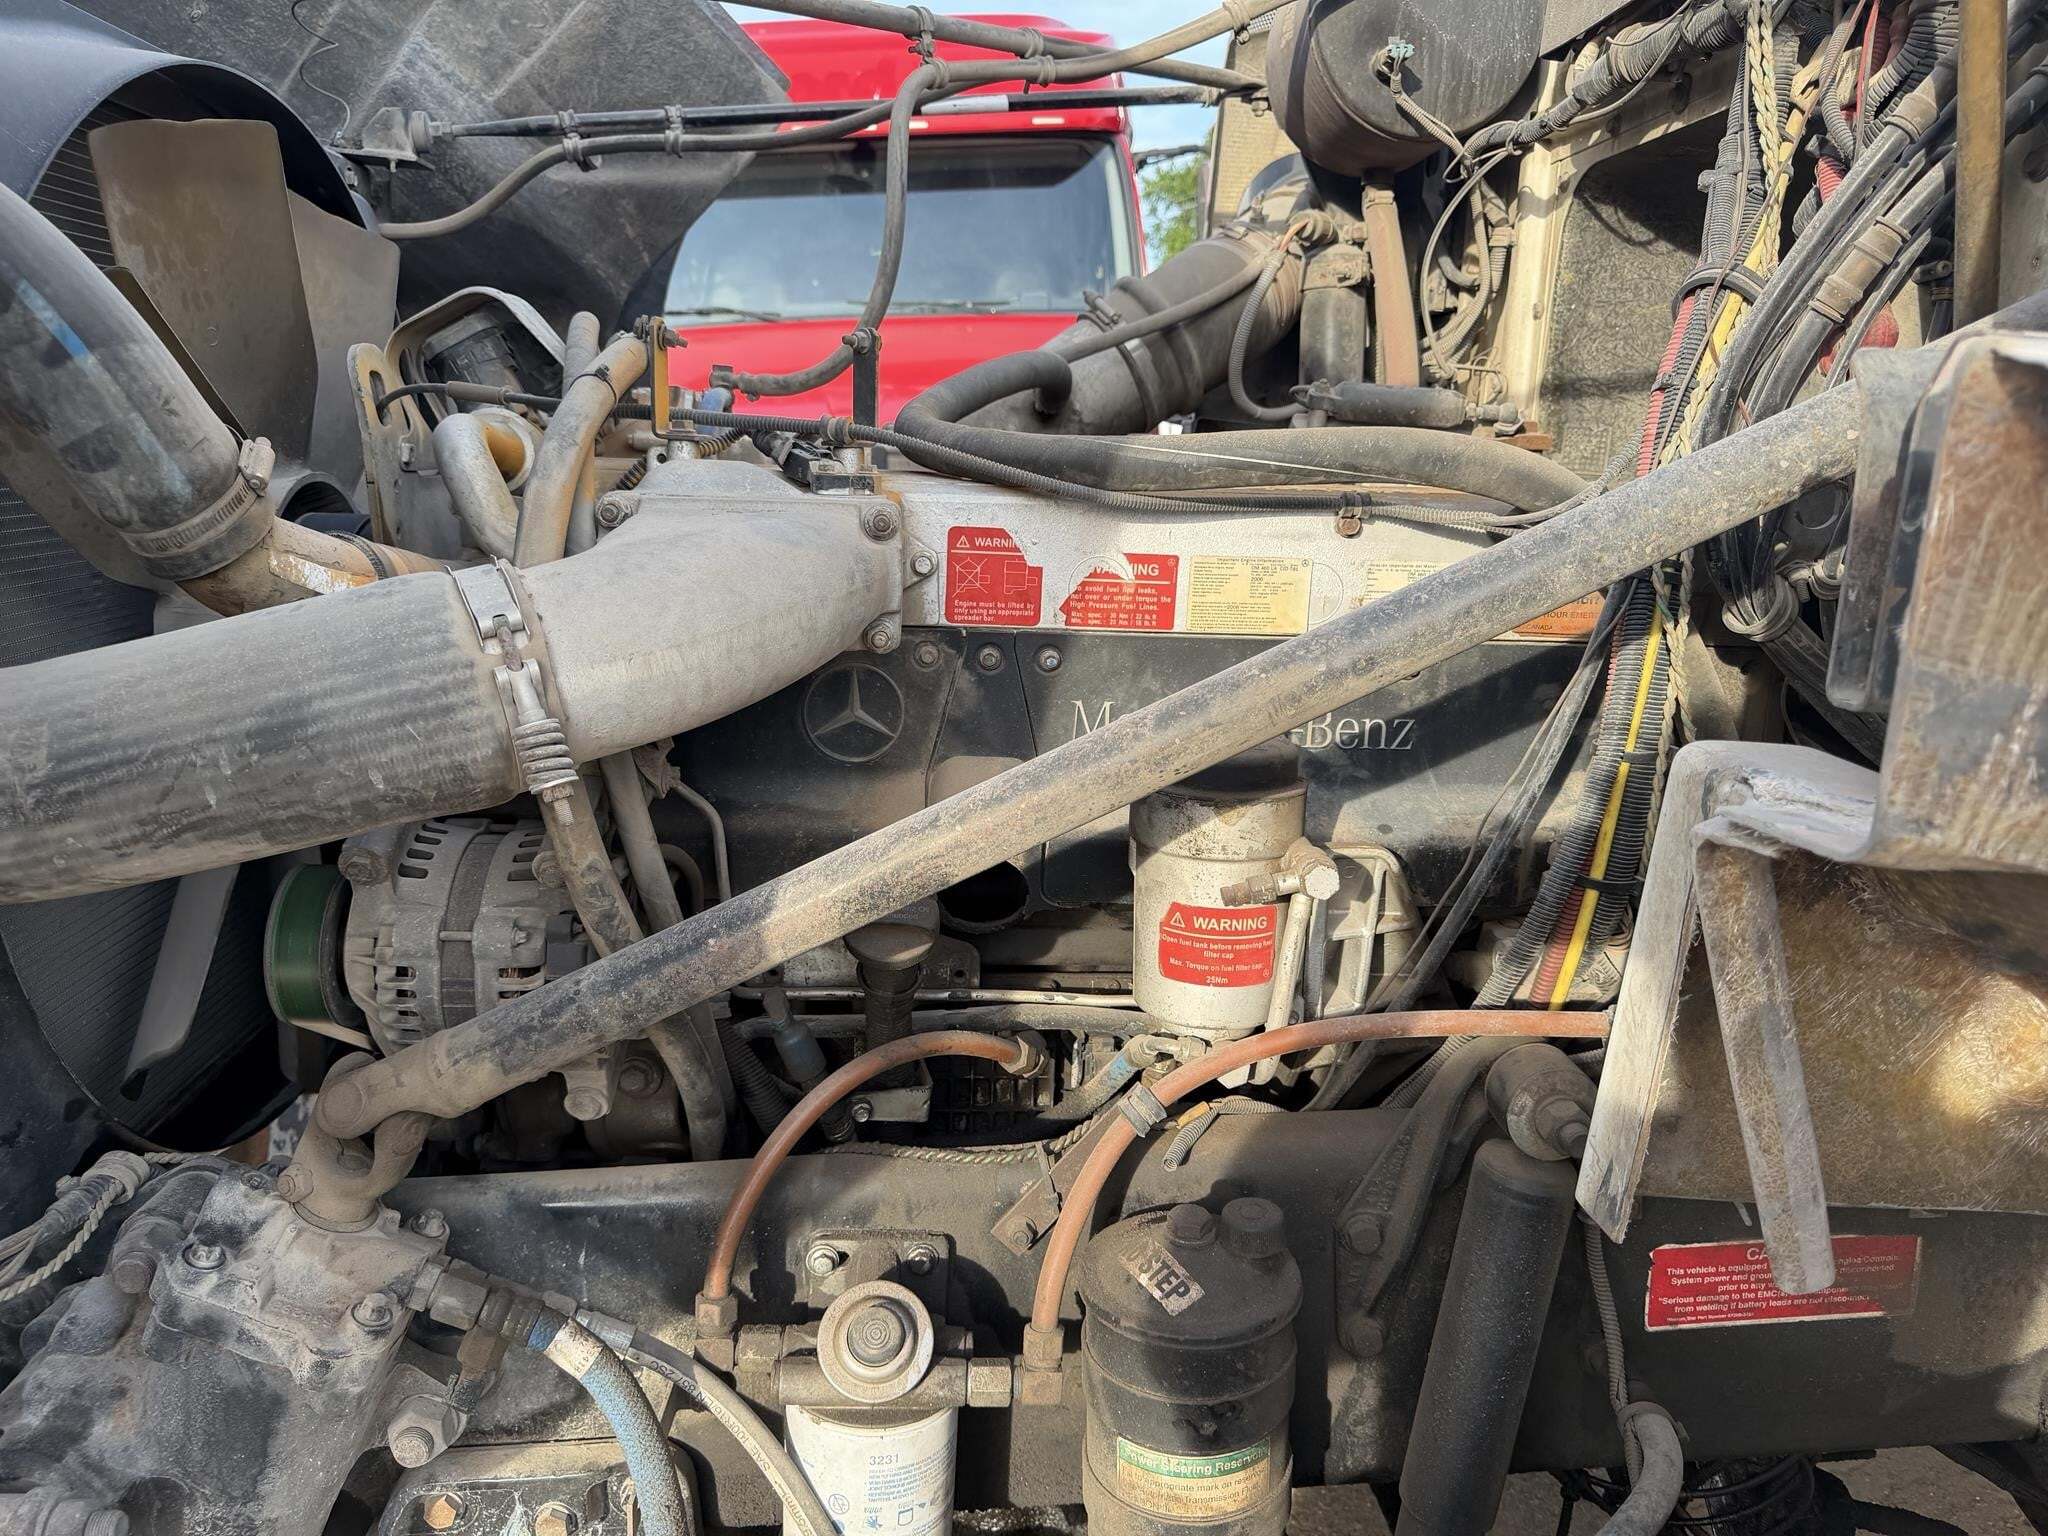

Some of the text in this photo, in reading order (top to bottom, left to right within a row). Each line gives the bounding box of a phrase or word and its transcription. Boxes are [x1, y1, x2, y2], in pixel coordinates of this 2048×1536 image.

[974, 537, 1016, 548] WARNI
[954, 600, 977, 608] Engine
[954, 608, 968, 616] only
[1193, 916, 1268, 931] WARNING
[1193, 941, 1208, 949] tank
[1233, 942, 1262, 950] removing
[1204, 950, 1220, 958] filter
[1186, 961, 1209, 972] Torque
[1222, 964, 1234, 972] fuel
[1137, 1246, 1192, 1300] STEP
[1667, 1262, 1768, 1276] This vehicle is equipped
[1672, 1276, 1702, 1286] System
[1704, 1274, 1730, 1284] power
[1718, 1284, 1738, 1292] prior
[1750, 1282, 1766, 1290] any
[1696, 1294, 1730, 1304] damage
[1674, 1305, 1694, 1313] from
[1696, 1302, 1729, 1312] welding
[1738, 1298, 1767, 1310] battery
[869, 1452, 899, 1466] 3231
[1162, 1457, 1212, 1475] Steering
[1197, 1482, 1219, 1492] mark
